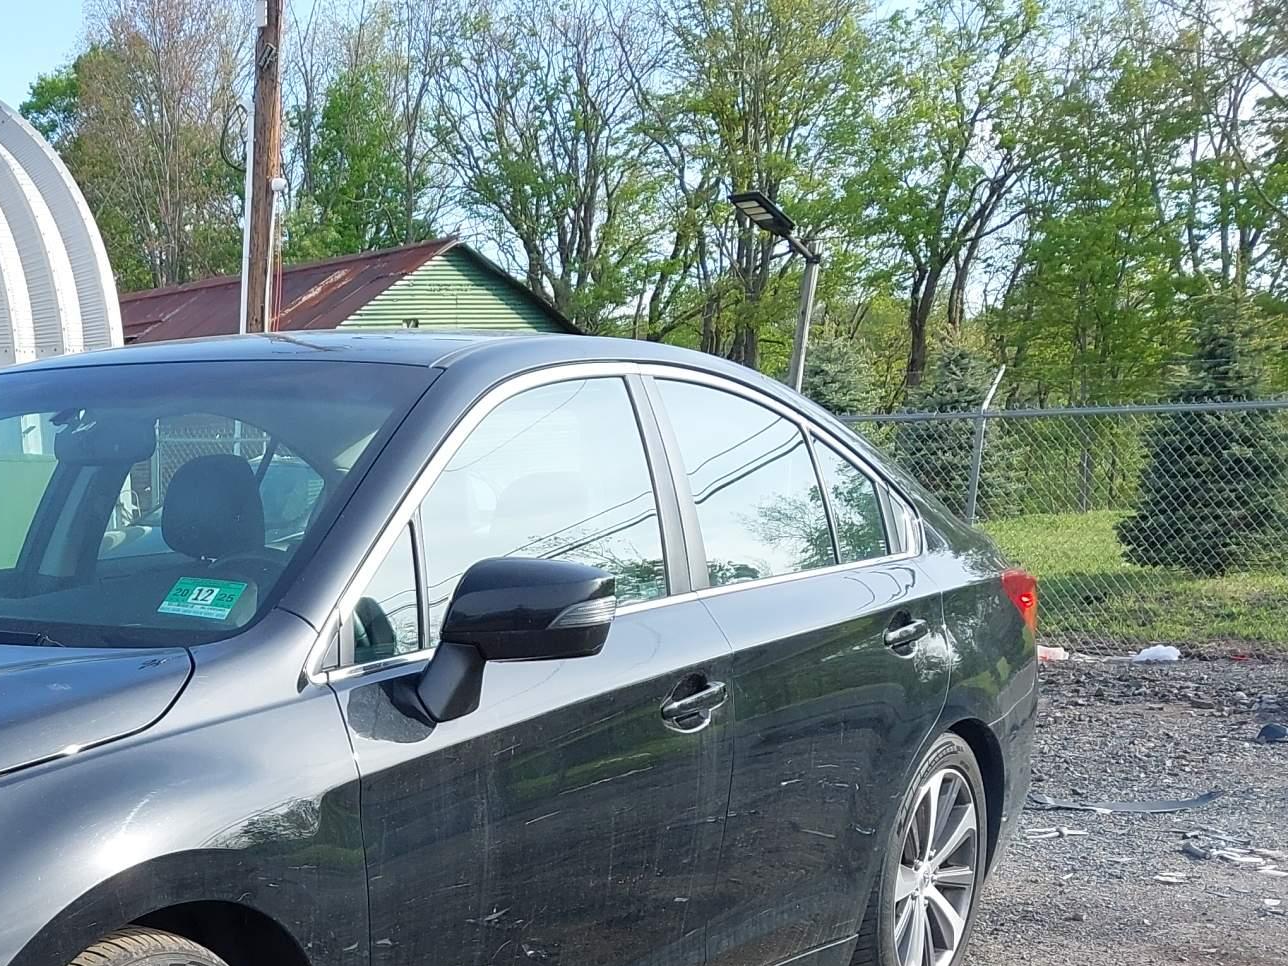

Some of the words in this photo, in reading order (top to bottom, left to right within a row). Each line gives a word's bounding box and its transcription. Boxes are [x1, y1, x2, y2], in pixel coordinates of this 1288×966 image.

[173, 588, 189, 597] 20
[192, 588, 214, 602] 12
[217, 593, 235, 602] 25
